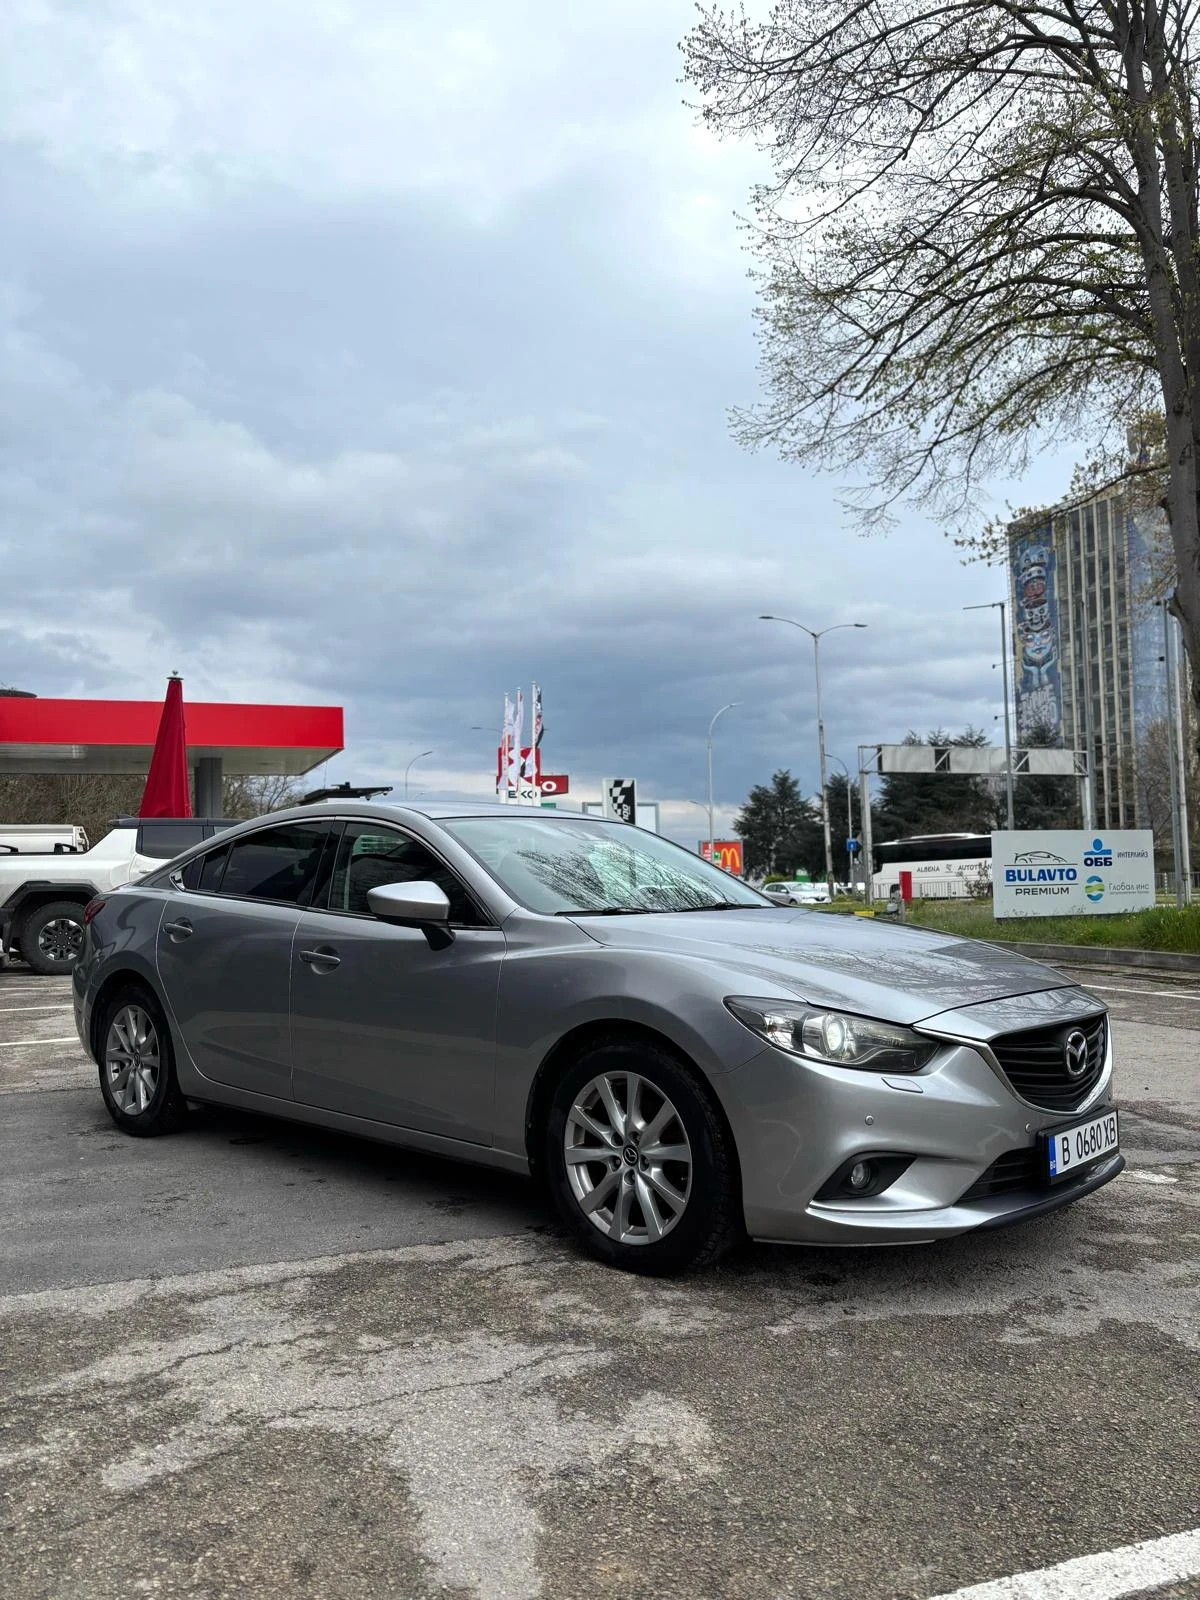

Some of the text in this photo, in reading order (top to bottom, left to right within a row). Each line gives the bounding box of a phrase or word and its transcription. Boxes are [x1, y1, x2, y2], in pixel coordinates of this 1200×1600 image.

[1083, 857, 1113, 867] ОББ
[1005, 868, 1077, 882] BULAVTO
[1015, 887, 1070, 896] PREMIUM
[1061, 1117, 1116, 1166] B 0680 XB
